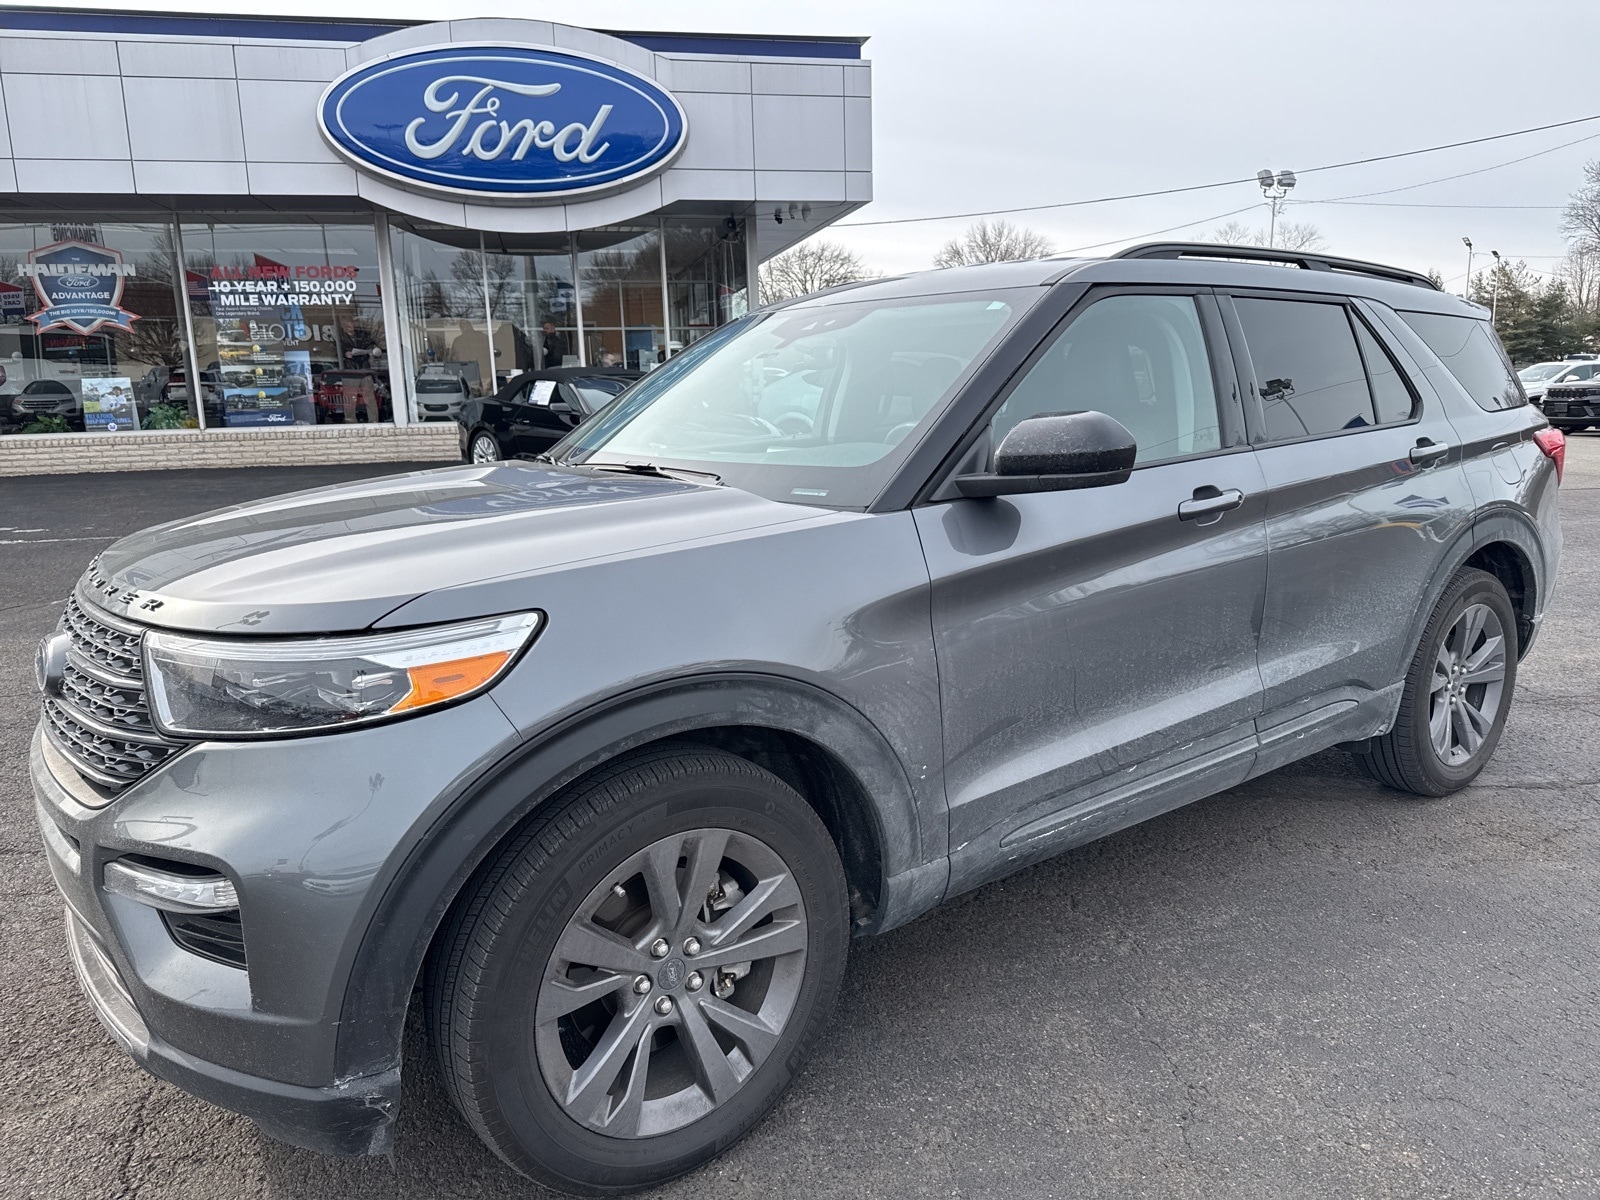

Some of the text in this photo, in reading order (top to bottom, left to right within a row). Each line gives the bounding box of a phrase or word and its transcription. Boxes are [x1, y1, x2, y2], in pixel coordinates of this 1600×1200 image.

[404, 75, 614, 164] Ford
[17, 263, 137, 277] HALDEMAN
[210, 265, 359, 279] ALL NEW FORDS
[66, 277, 92, 287] Ford
[212, 281, 231, 293] 10
[233, 281, 278, 293] YEAR
[293, 280, 357, 294] 150,000
[51, 291, 111, 300] ADVANTAGE
[221, 294, 352, 306] MILE WARRANTY
[267, 413, 287, 422] Ford
[577, 823, 634, 874] PRIMACY
